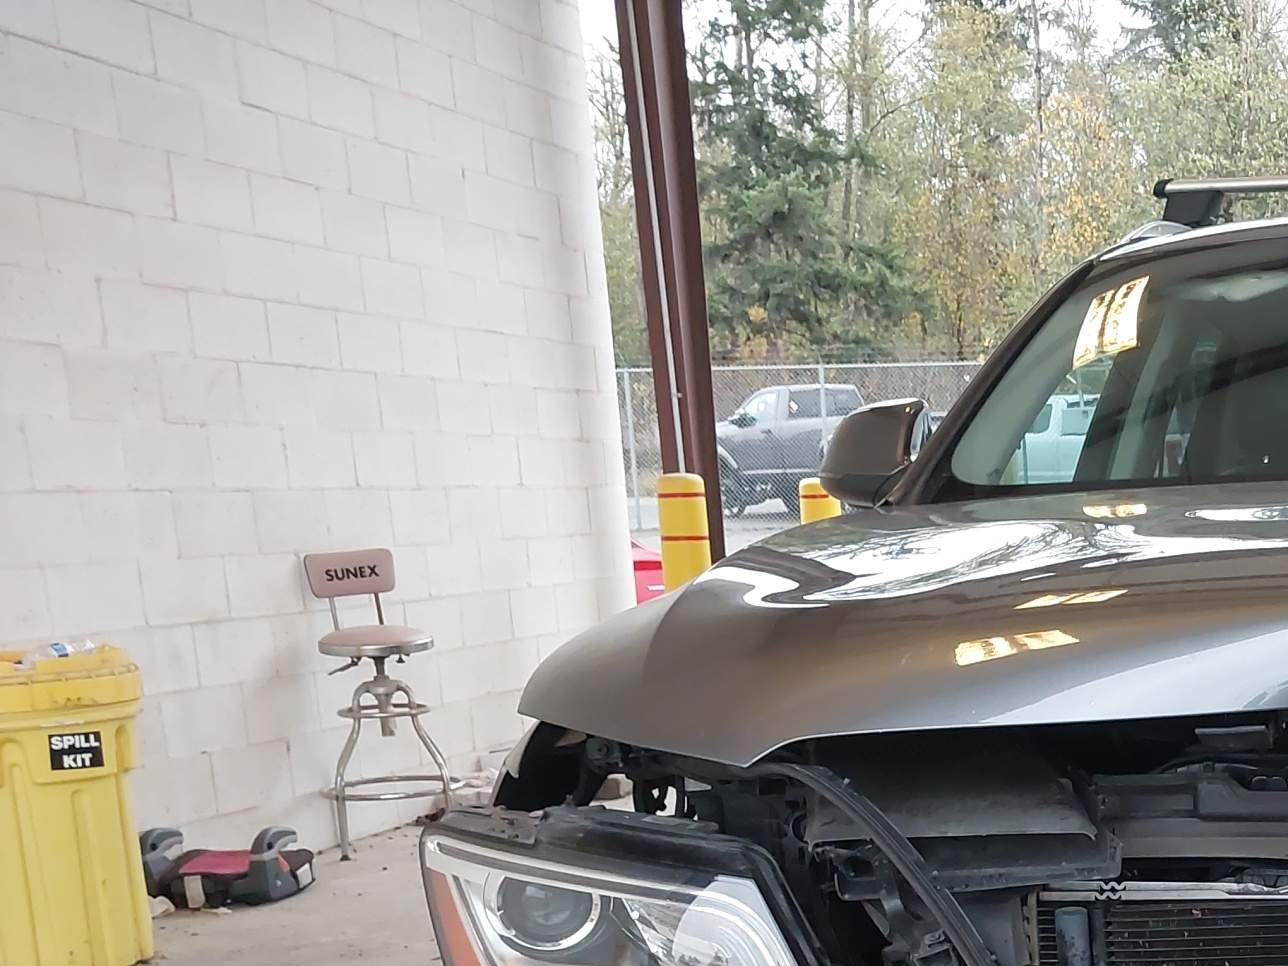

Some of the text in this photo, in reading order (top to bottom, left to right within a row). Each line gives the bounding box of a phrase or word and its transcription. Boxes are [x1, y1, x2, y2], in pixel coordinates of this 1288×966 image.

[325, 565, 379, 581] SUNEX
[51, 734, 100, 750] SPILL
[62, 753, 92, 768] KIT
